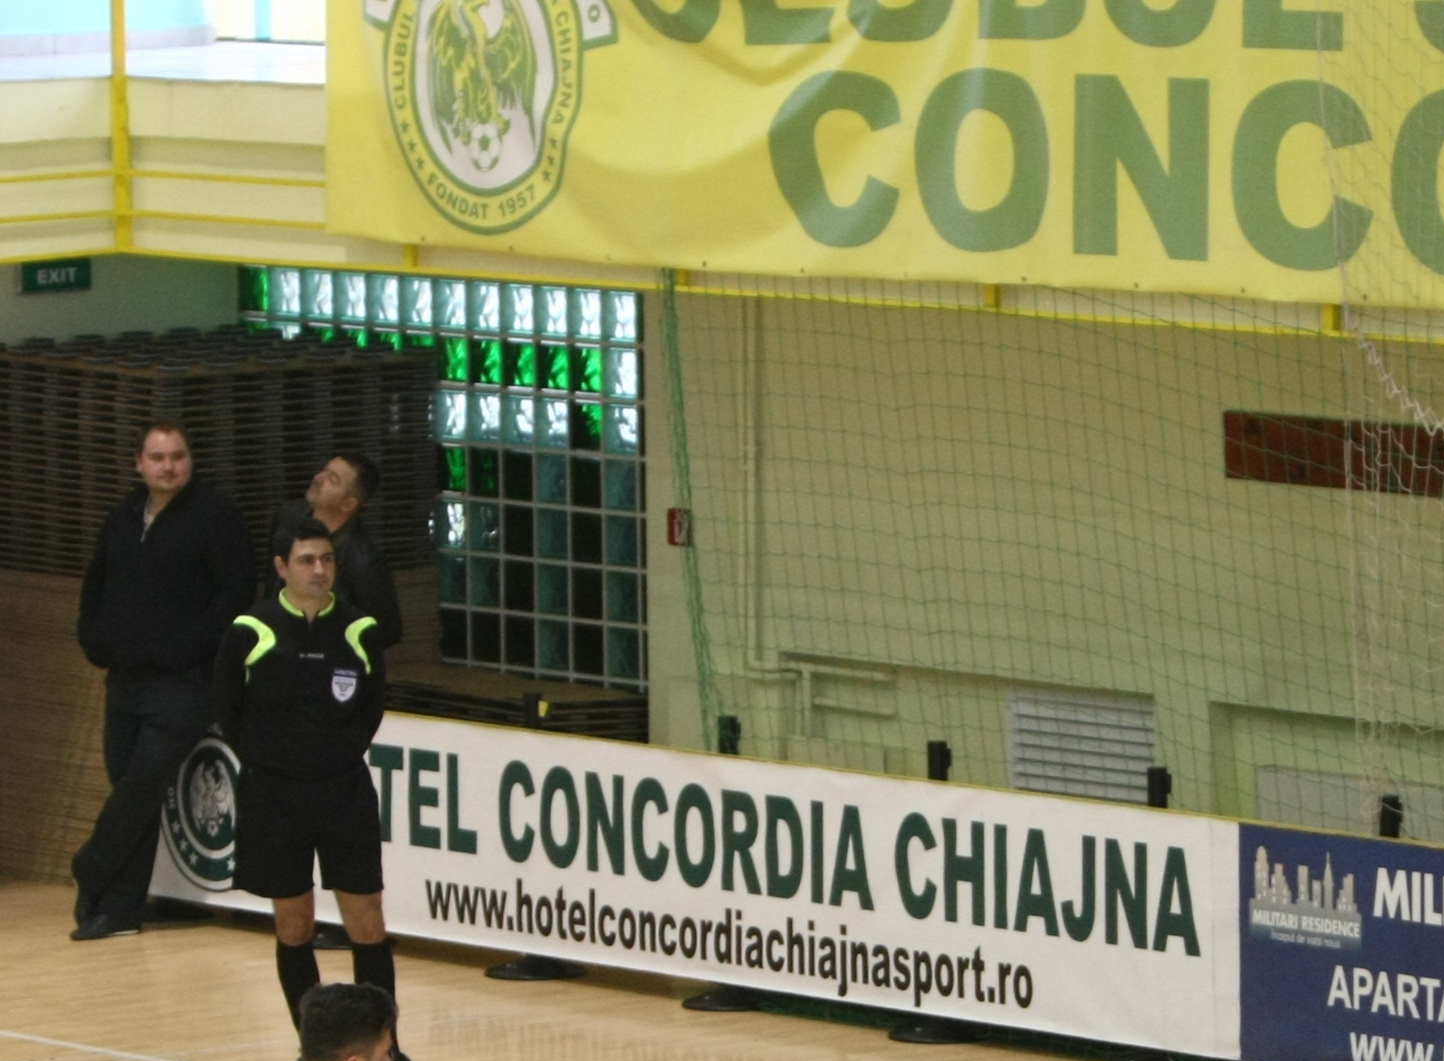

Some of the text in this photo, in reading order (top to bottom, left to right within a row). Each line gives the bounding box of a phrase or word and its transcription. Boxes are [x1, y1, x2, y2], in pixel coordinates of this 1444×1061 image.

[552, 10, 573, 124] CHIAJNA
[427, 172, 535, 220] FONDAT 1957
[37, 266, 78, 285] EXIT
[498, 759, 875, 911] CONCORDIA
[894, 811, 1202, 957] CHIAJNA
[425, 877, 1034, 1009] www.hotelconcordiachiajnasport.ro
[1252, 908, 1299, 930] MILITARI
[1301, 915, 1361, 939] RESIDENCE
